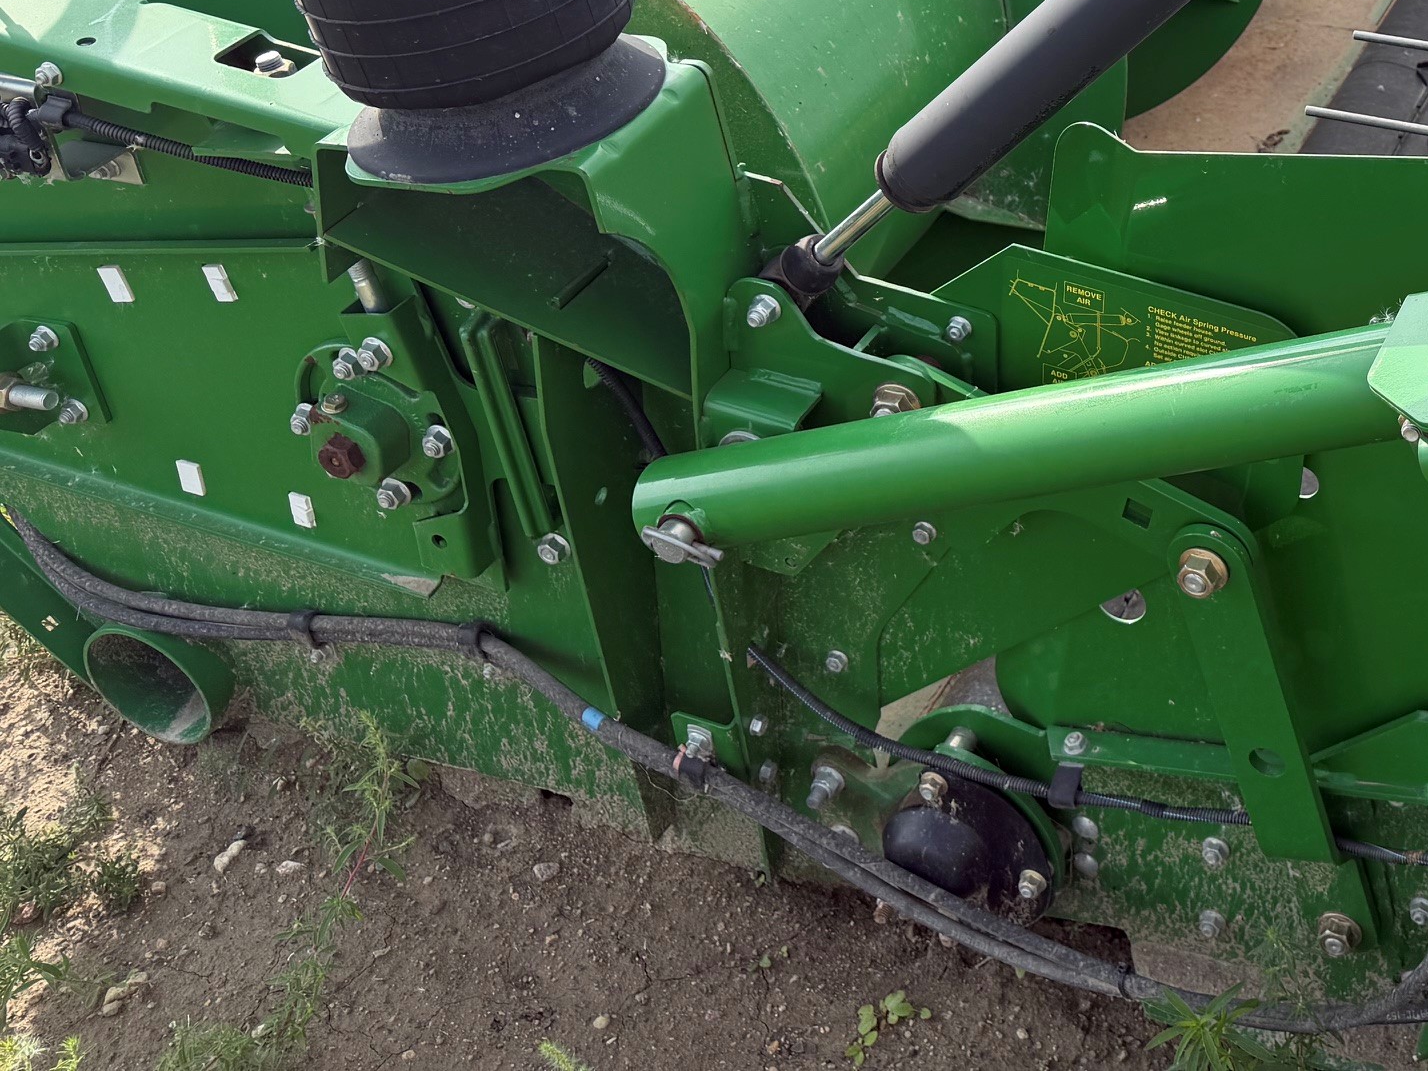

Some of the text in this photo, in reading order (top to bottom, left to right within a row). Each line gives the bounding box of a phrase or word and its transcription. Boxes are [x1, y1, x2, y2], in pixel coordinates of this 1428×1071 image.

[1066, 285, 1102, 301] REMOVE
[1076, 297, 1091, 306] AIR
[1148, 306, 1257, 342] CHECK Air Spring Pressure
[1156, 316, 1172, 324] Raise
[1173, 320, 1192, 330] feeder
[1194, 326, 1214, 336] house.
[1154, 334, 1174, 344] Within
[1174, 341, 1196, 350] curved
[1172, 327, 1192, 336] wheels
[1203, 336, 1226, 347] ground.
[1154, 347, 1177, 357] Outside
[1164, 344, 1182, 352] action
[1050, 369, 1068, 380] ADD
